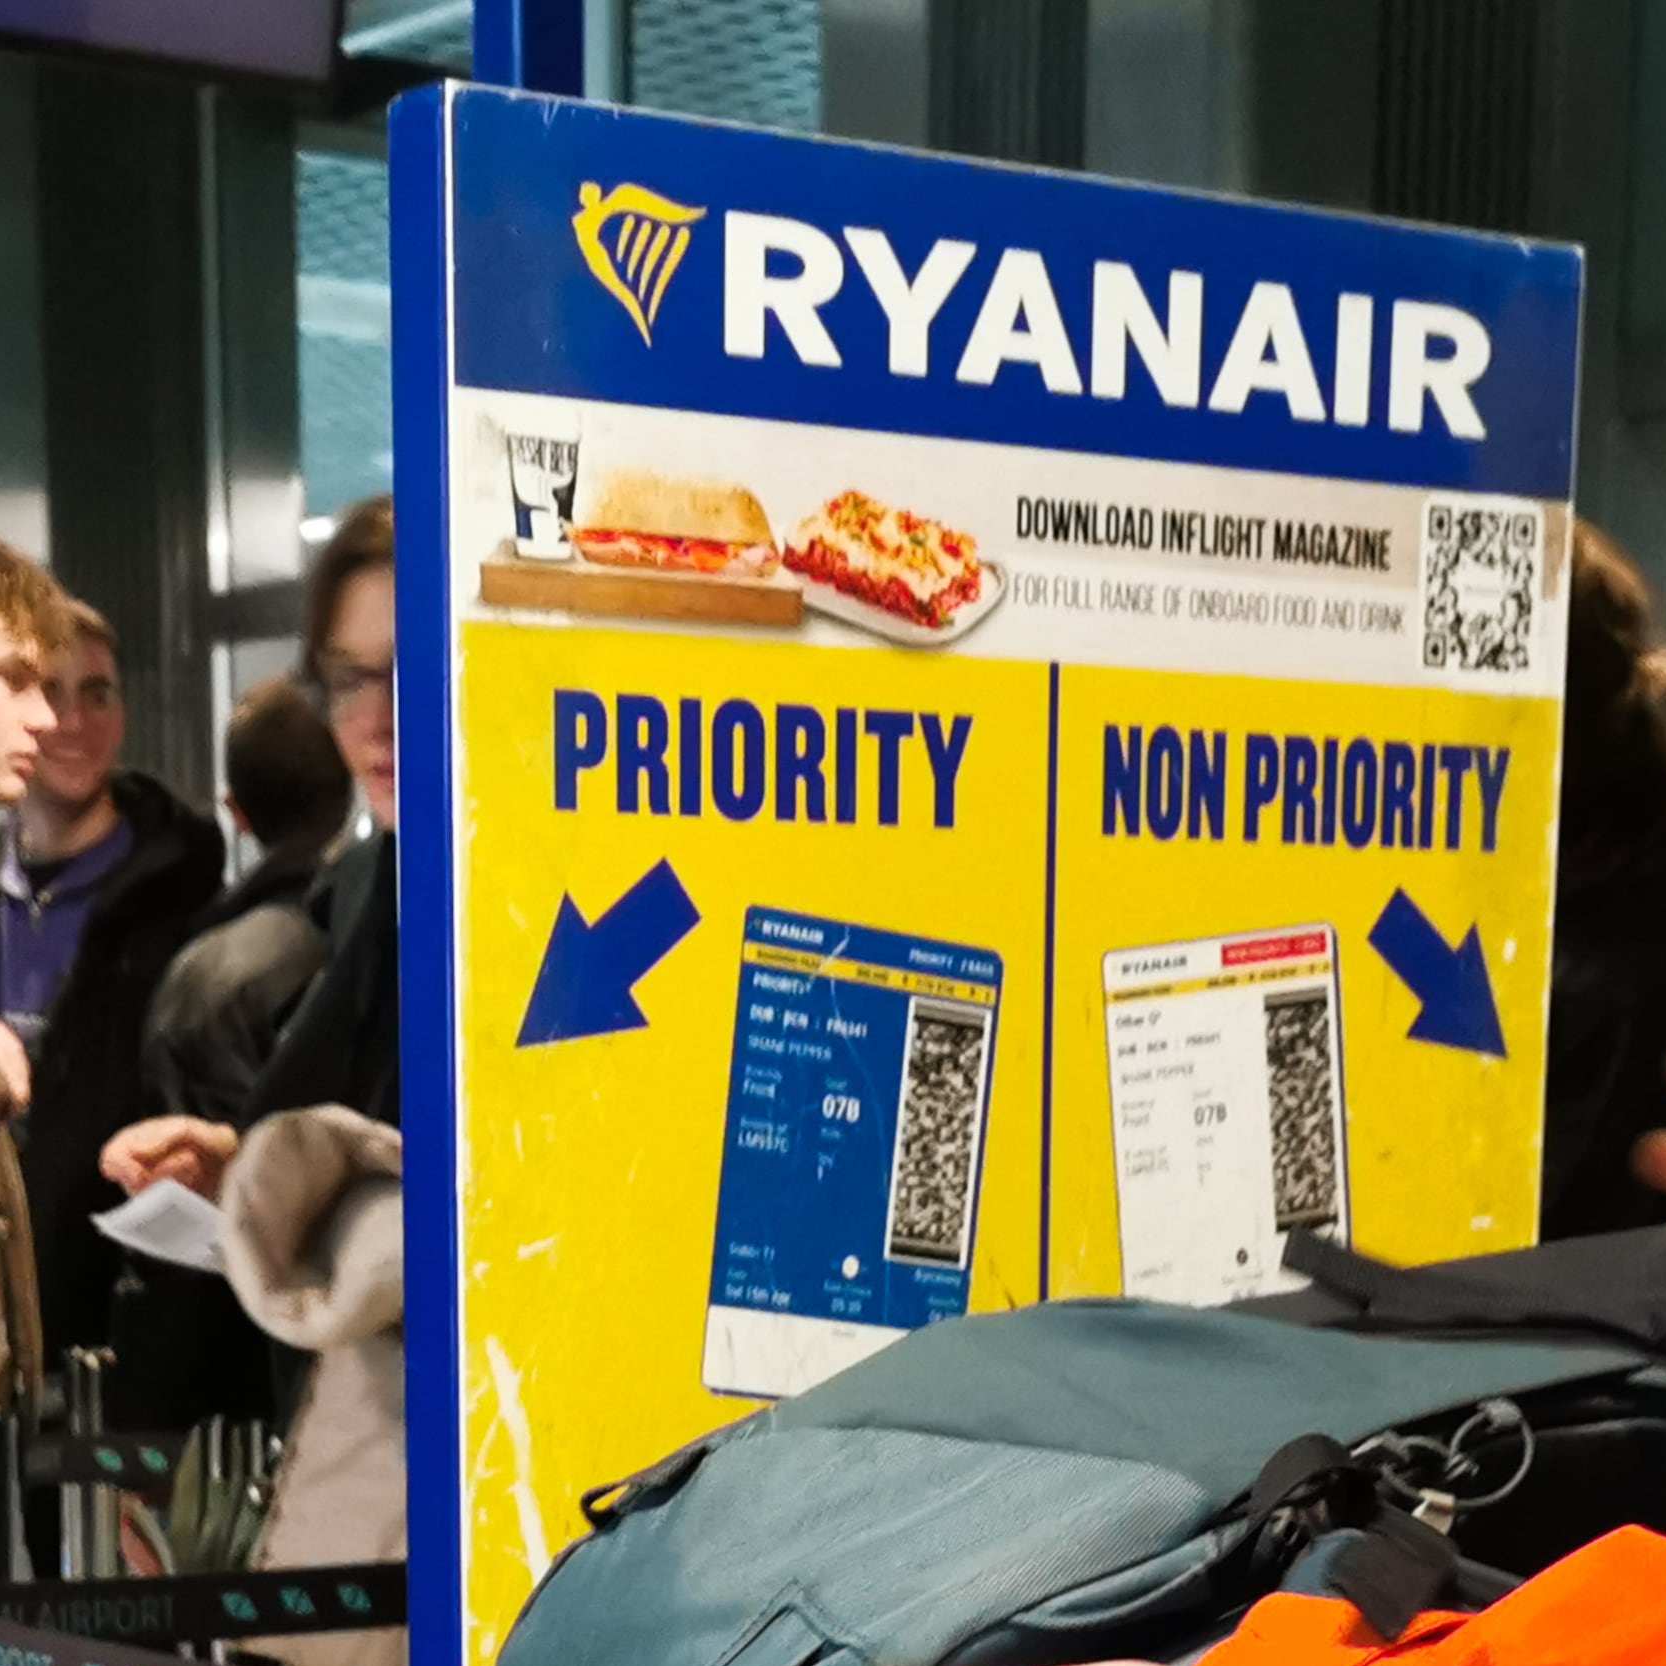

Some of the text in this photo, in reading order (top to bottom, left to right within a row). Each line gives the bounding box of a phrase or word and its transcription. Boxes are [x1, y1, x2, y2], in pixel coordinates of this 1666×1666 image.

[723, 209, 1492, 441] RYANAIR
[1016, 496, 1392, 572] DOWNLOAD INFLIGHT MAGAZINE
[1014, 573, 1405, 636] FOR FULL RANGE OF ONBOARD FOOD AND DRINK
[554, 688, 974, 829] PRIORITY
[1102, 723, 1511, 853] NON PRIORITY
[761, 919, 824, 945] RYANAIR
[1121, 955, 1188, 977] RYANAIR
[822, 1093, 860, 1123] 07B
[1193, 1101, 1227, 1127] 07B
